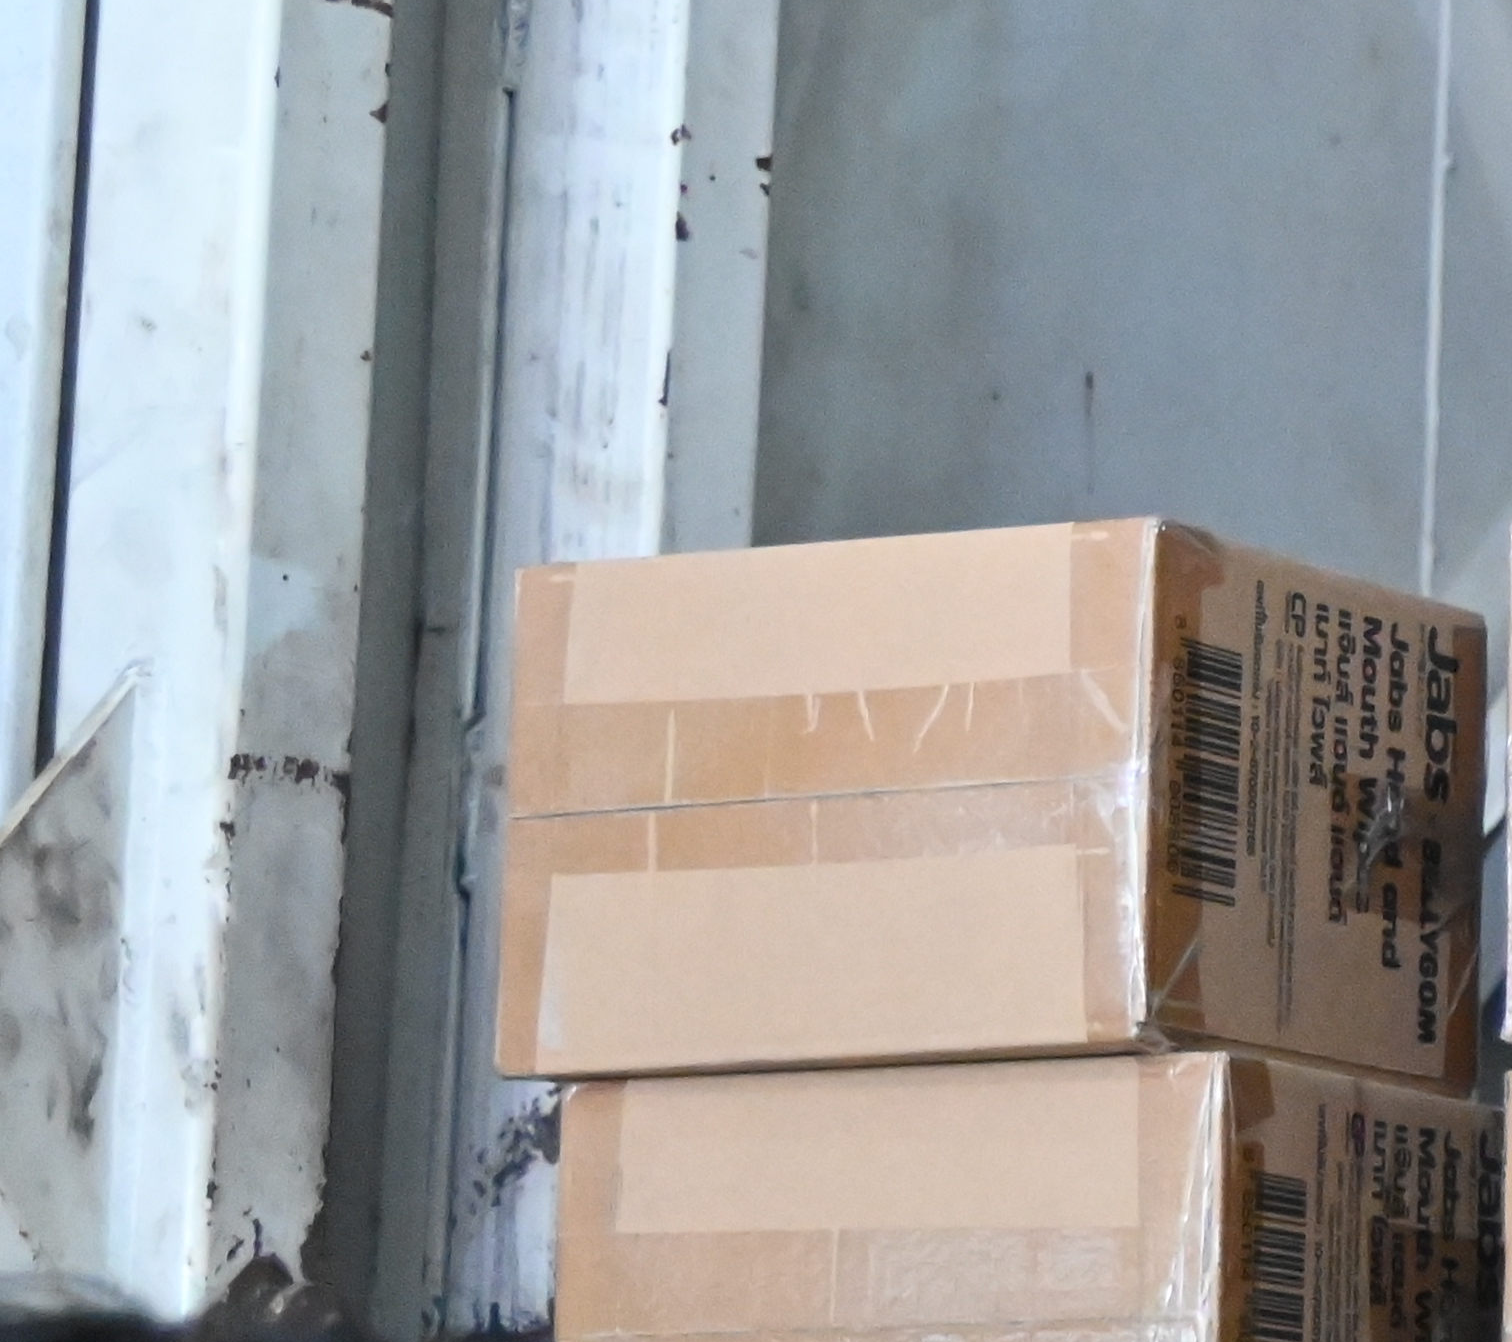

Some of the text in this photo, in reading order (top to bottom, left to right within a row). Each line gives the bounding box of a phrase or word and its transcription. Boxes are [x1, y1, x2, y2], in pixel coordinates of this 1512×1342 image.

[1286, 592, 1307, 638] CP
[1358, 616, 1382, 759] Mouth
[1423, 626, 1459, 799] Jabs
[1381, 622, 1409, 969] Jabs and
